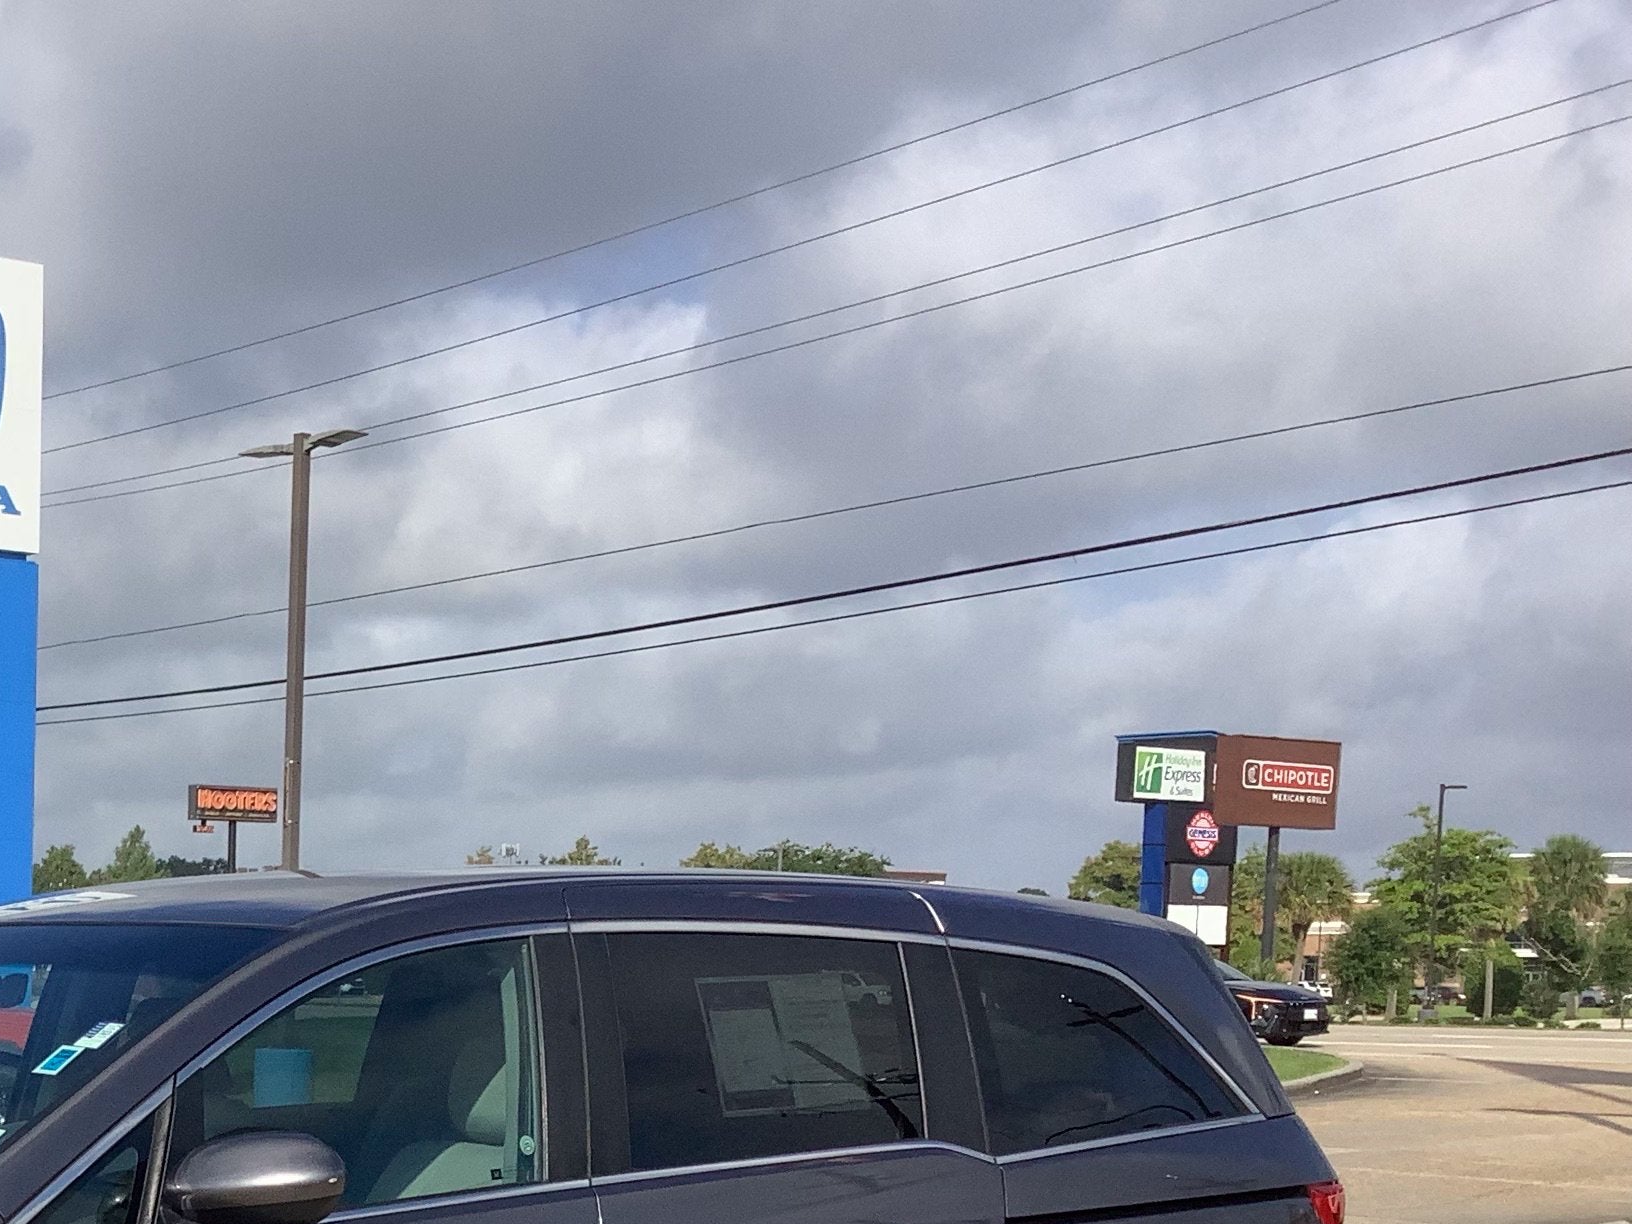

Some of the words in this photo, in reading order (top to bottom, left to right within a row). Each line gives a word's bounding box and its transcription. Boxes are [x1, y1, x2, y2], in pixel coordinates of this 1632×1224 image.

[1164, 765, 1201, 783] Express
[1264, 768, 1330, 787] CHIPOTLE
[197, 788, 277, 813] HOOTERS
[1272, 793, 1304, 803] MEXICAN
[1306, 795, 1328, 805] GRILL
[1188, 828, 1217, 839] GENESIS
